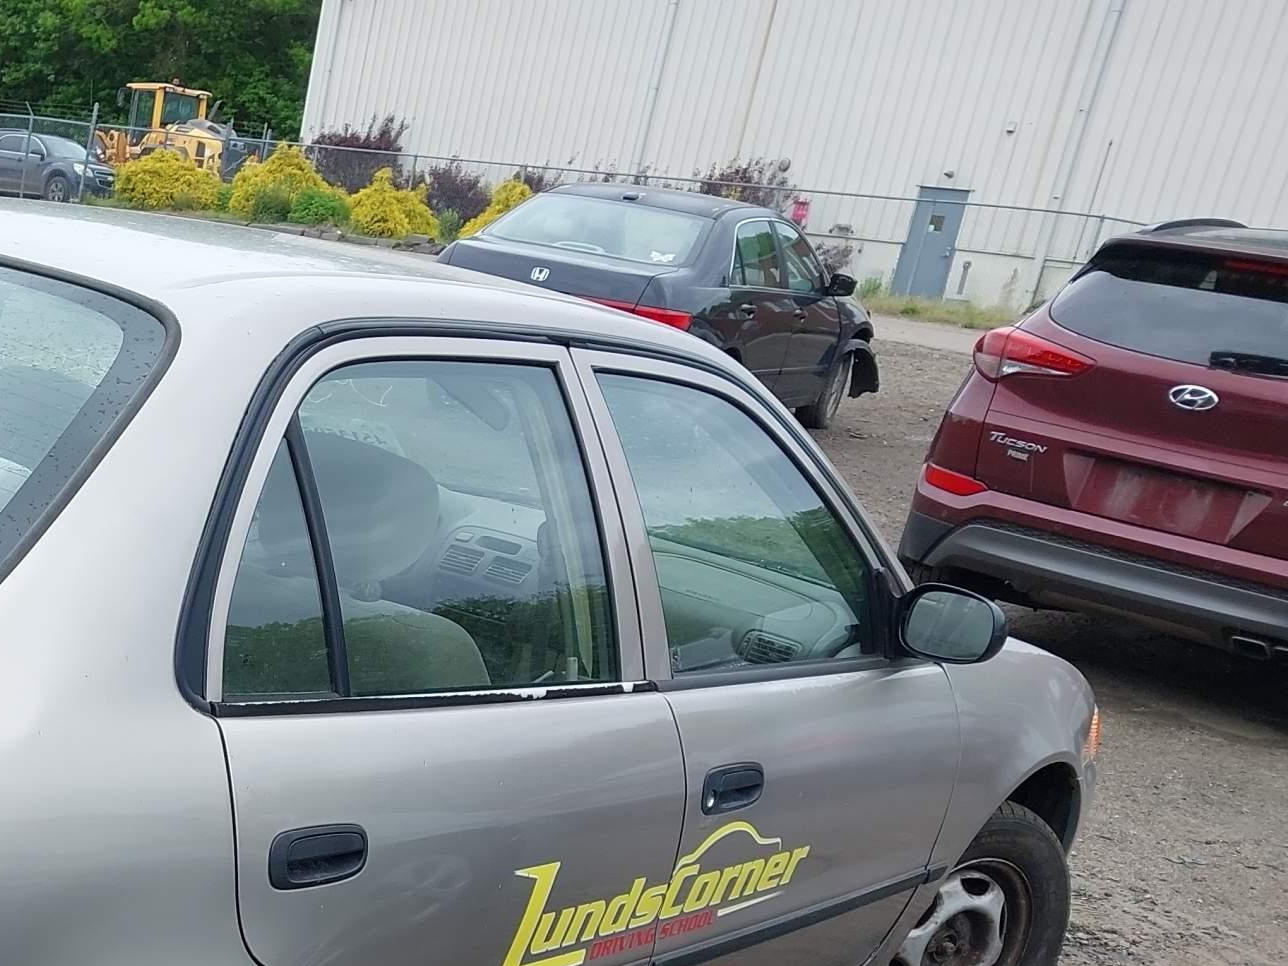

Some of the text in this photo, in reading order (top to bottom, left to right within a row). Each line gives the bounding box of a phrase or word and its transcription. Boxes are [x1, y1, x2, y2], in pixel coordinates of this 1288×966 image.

[989, 430, 1048, 453] TUCSON
[589, 909, 713, 961] DRIVING SCHOOL
